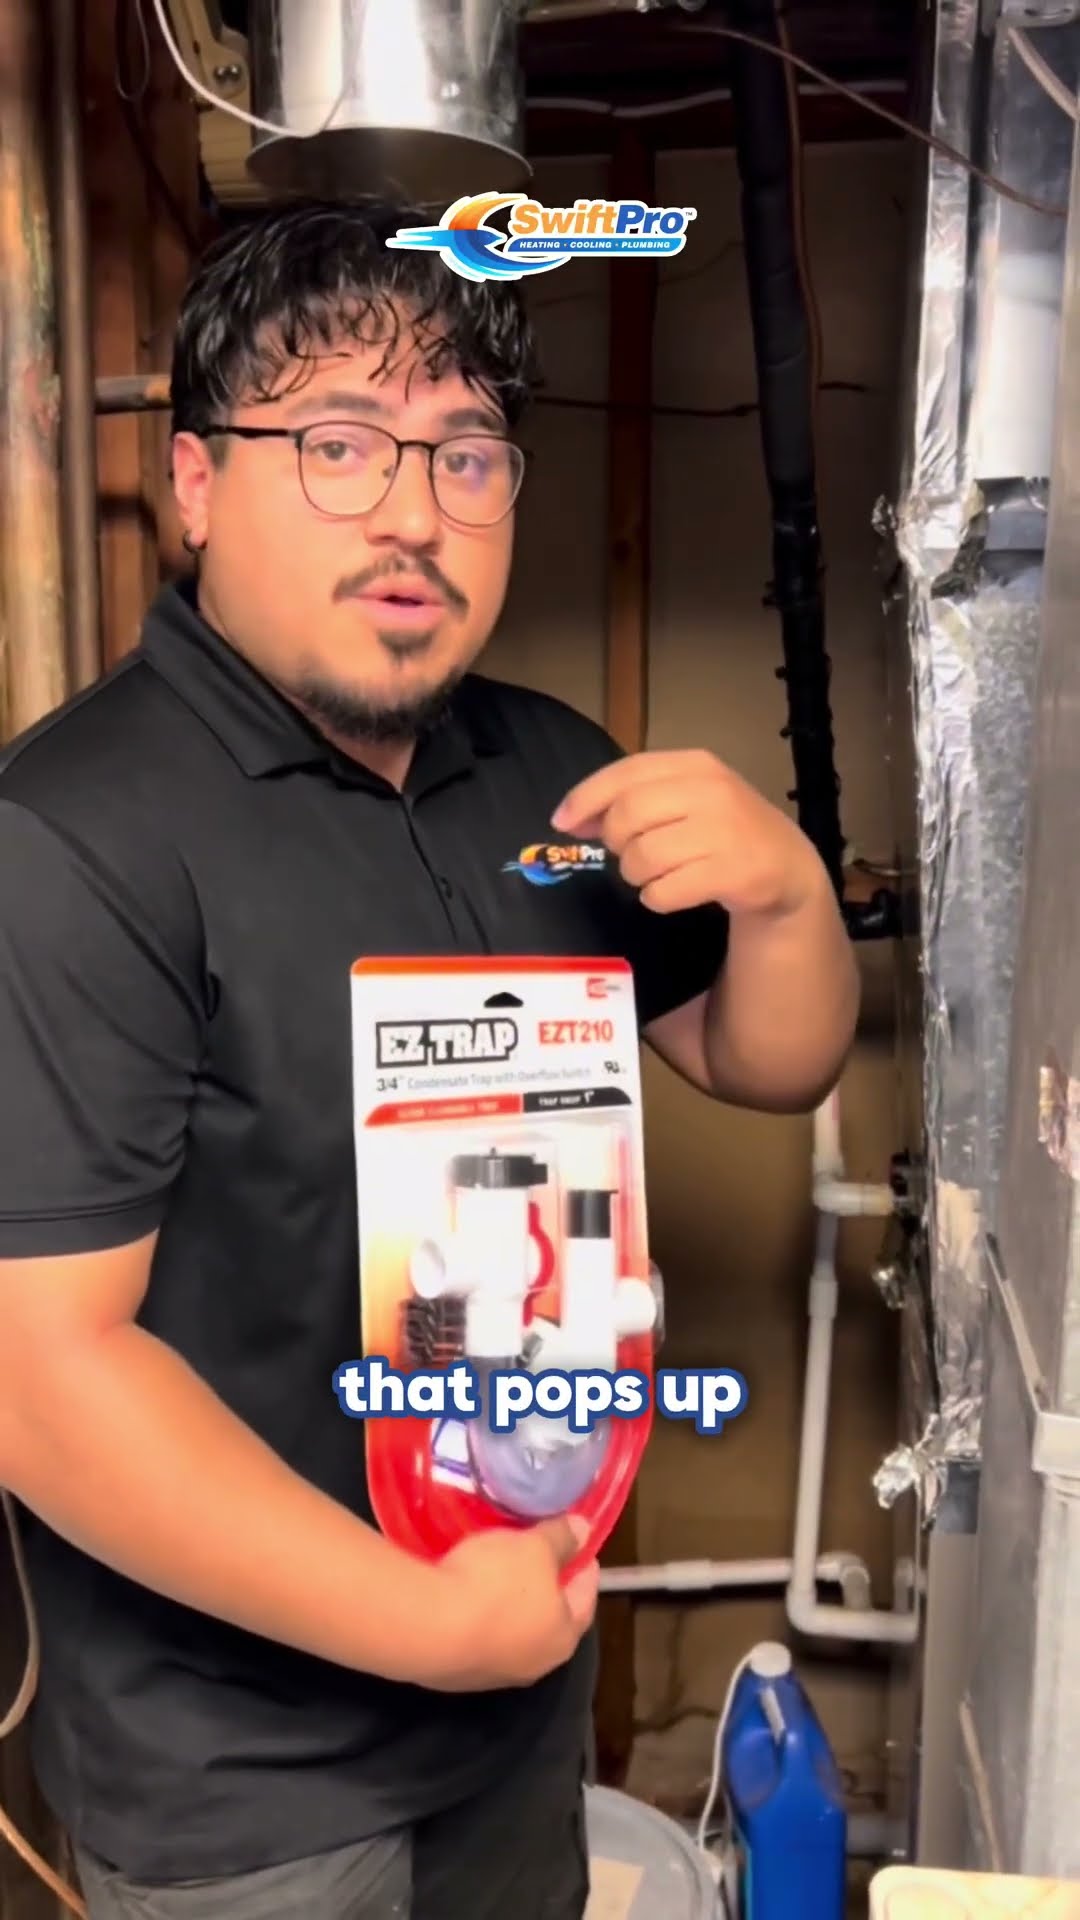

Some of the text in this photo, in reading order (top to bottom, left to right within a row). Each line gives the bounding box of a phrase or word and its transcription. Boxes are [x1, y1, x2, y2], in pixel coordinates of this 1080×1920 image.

[378, 1020, 517, 1066] EZ TRAP
[537, 1019, 614, 1045] EZT210
